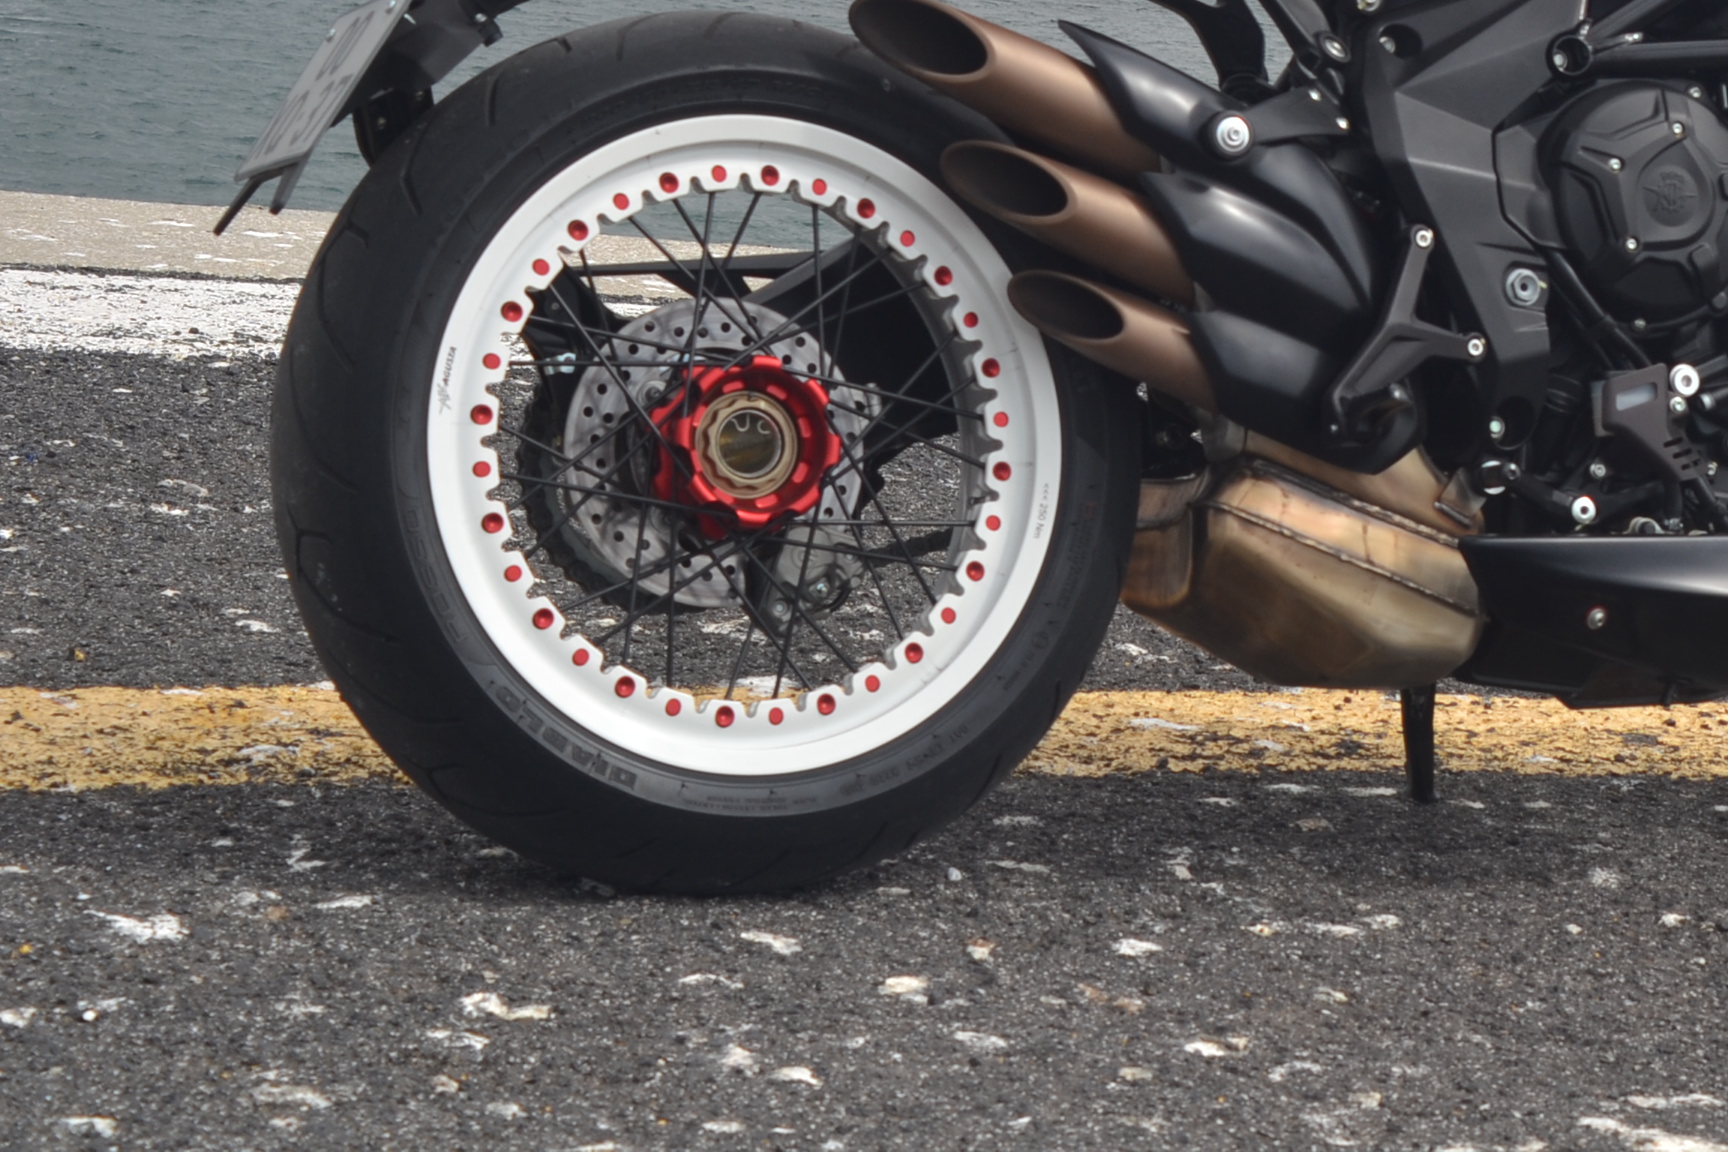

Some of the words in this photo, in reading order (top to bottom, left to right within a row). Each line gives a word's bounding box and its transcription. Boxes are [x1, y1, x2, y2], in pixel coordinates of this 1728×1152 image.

[442, 346, 457, 386] AGUSTA
[406, 508, 468, 642] ROSSO
[496, 688, 638, 790] DIABLO
